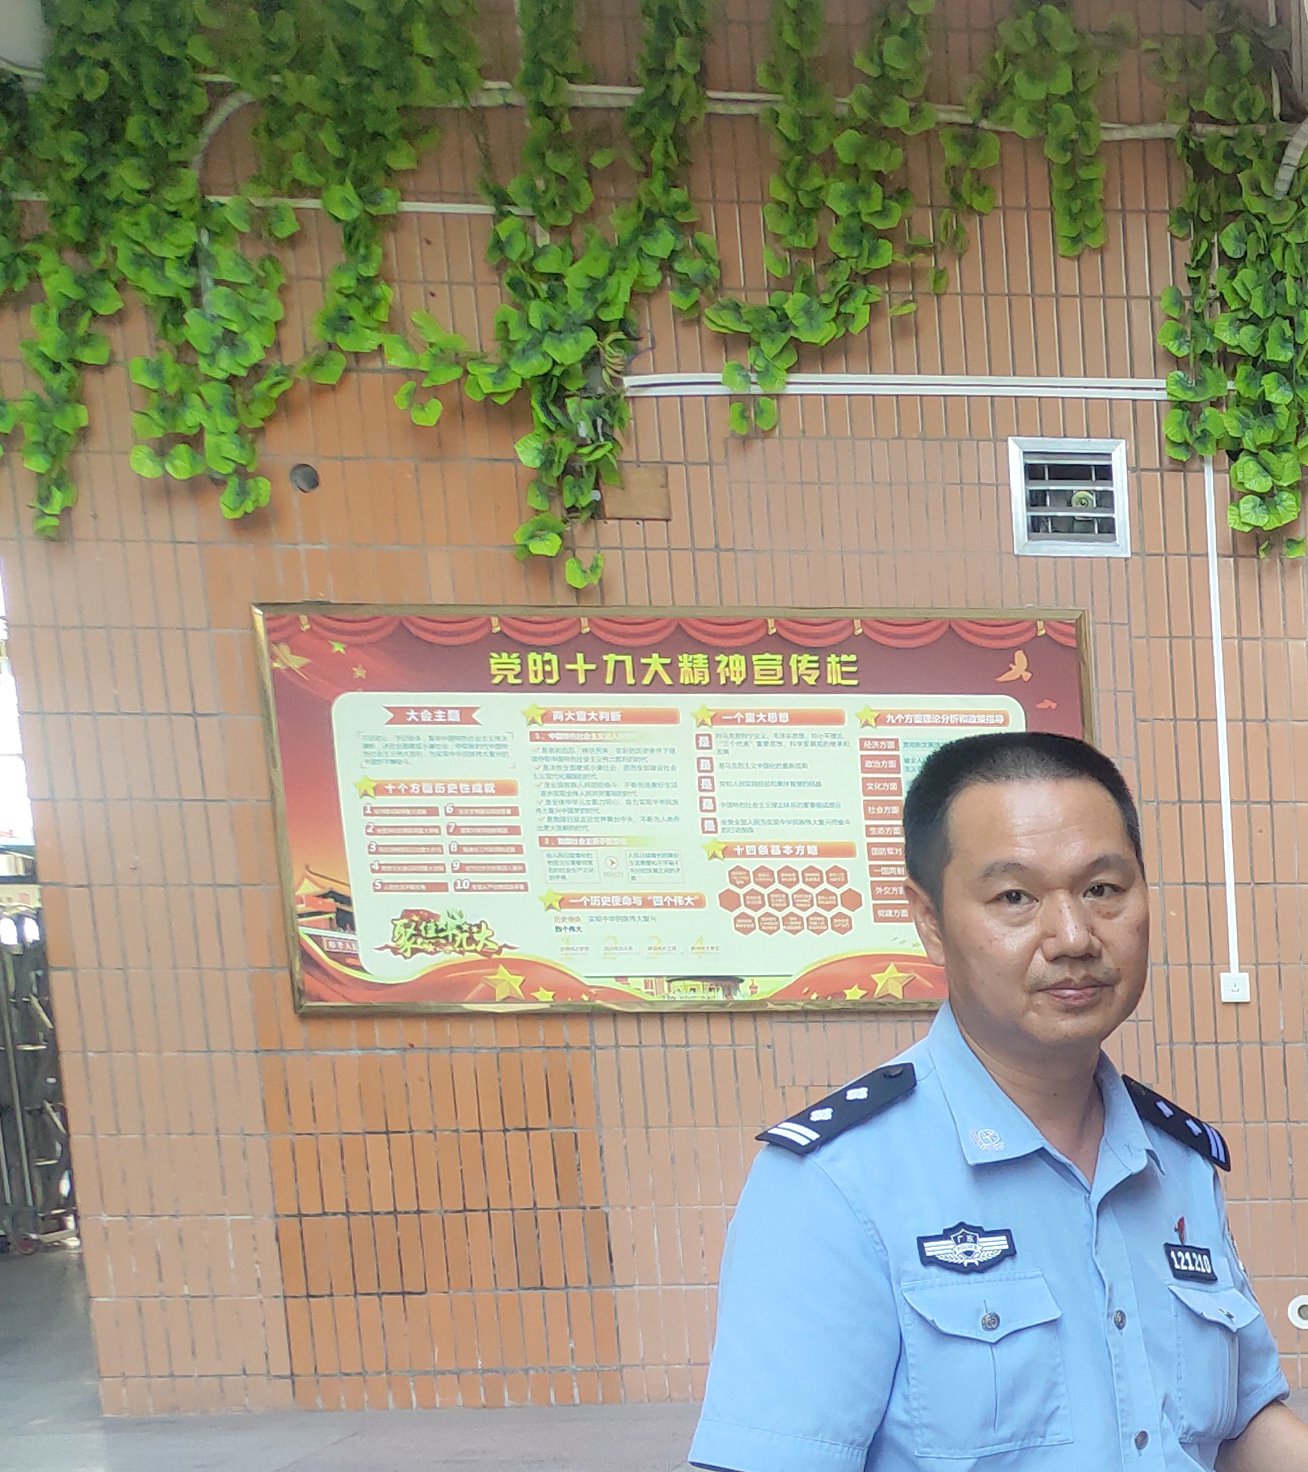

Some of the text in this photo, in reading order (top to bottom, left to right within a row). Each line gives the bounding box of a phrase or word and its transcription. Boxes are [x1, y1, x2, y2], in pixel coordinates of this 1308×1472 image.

[489, 653, 859, 686] 党的十九大精神宣传栏
[406, 709, 461, 722] 大会主题
[1170, 1250, 1212, 1274] 121210
